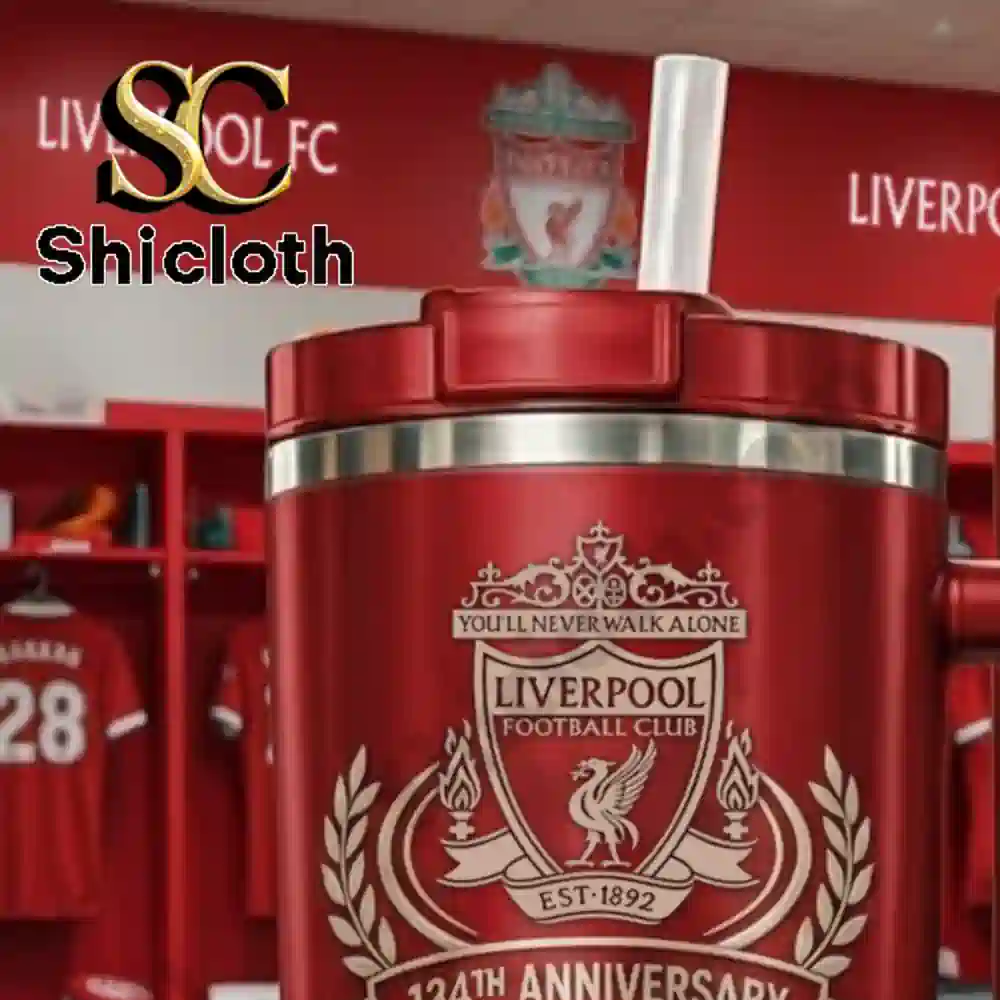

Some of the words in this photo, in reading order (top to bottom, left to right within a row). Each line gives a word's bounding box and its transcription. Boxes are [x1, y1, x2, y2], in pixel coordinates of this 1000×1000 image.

[288, 119, 339, 174] FC
[459, 615, 528, 633] YOU'LL
[532, 615, 599, 633] NEVER
[603, 615, 665, 633] WALK
[668, 615, 741, 633] ALONE
[495, 676, 706, 709] LIVERPOOL
[0, 679, 87, 765] 28
[502, 717, 626, 737] FOOTBALL
[632, 717, 698, 736] CLUB
